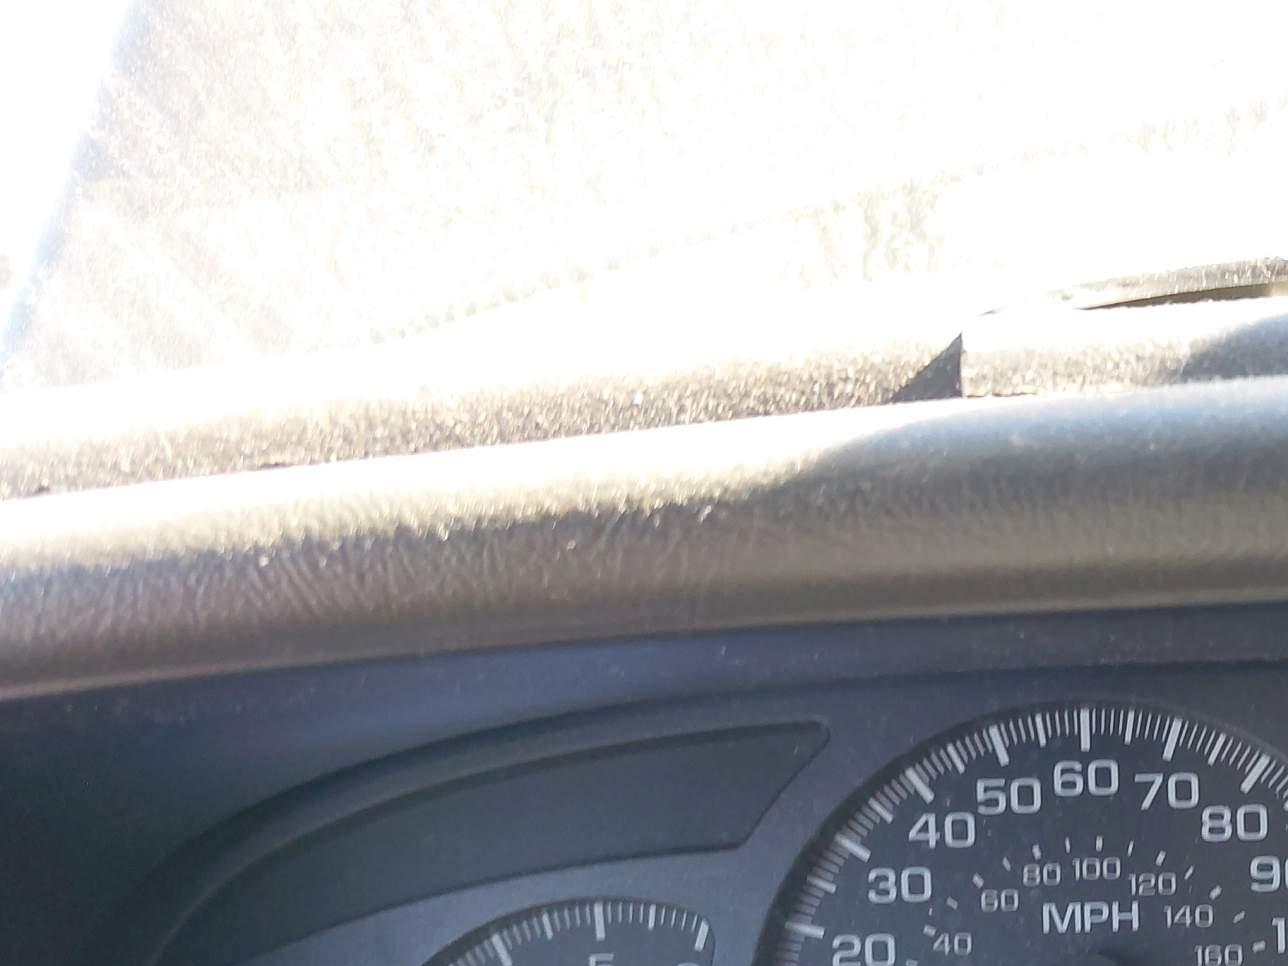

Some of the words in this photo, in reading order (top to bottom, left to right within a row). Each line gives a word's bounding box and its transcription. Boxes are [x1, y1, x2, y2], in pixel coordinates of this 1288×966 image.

[1053, 759, 1119, 796] 60
[1135, 772, 1199, 810] 70
[976, 777, 1042, 814] 50
[908, 812, 975, 848] 40
[1201, 804, 1268, 841] 80
[1022, 863, 1061, 886] 80
[1072, 858, 1121, 879] 100
[1129, 872, 1176, 895] 120
[867, 868, 932, 904] 30
[981, 889, 1019, 912] 60
[1042, 902, 1140, 934] MPH
[1164, 905, 1213, 928] 140
[933, 933, 972, 956] 40
